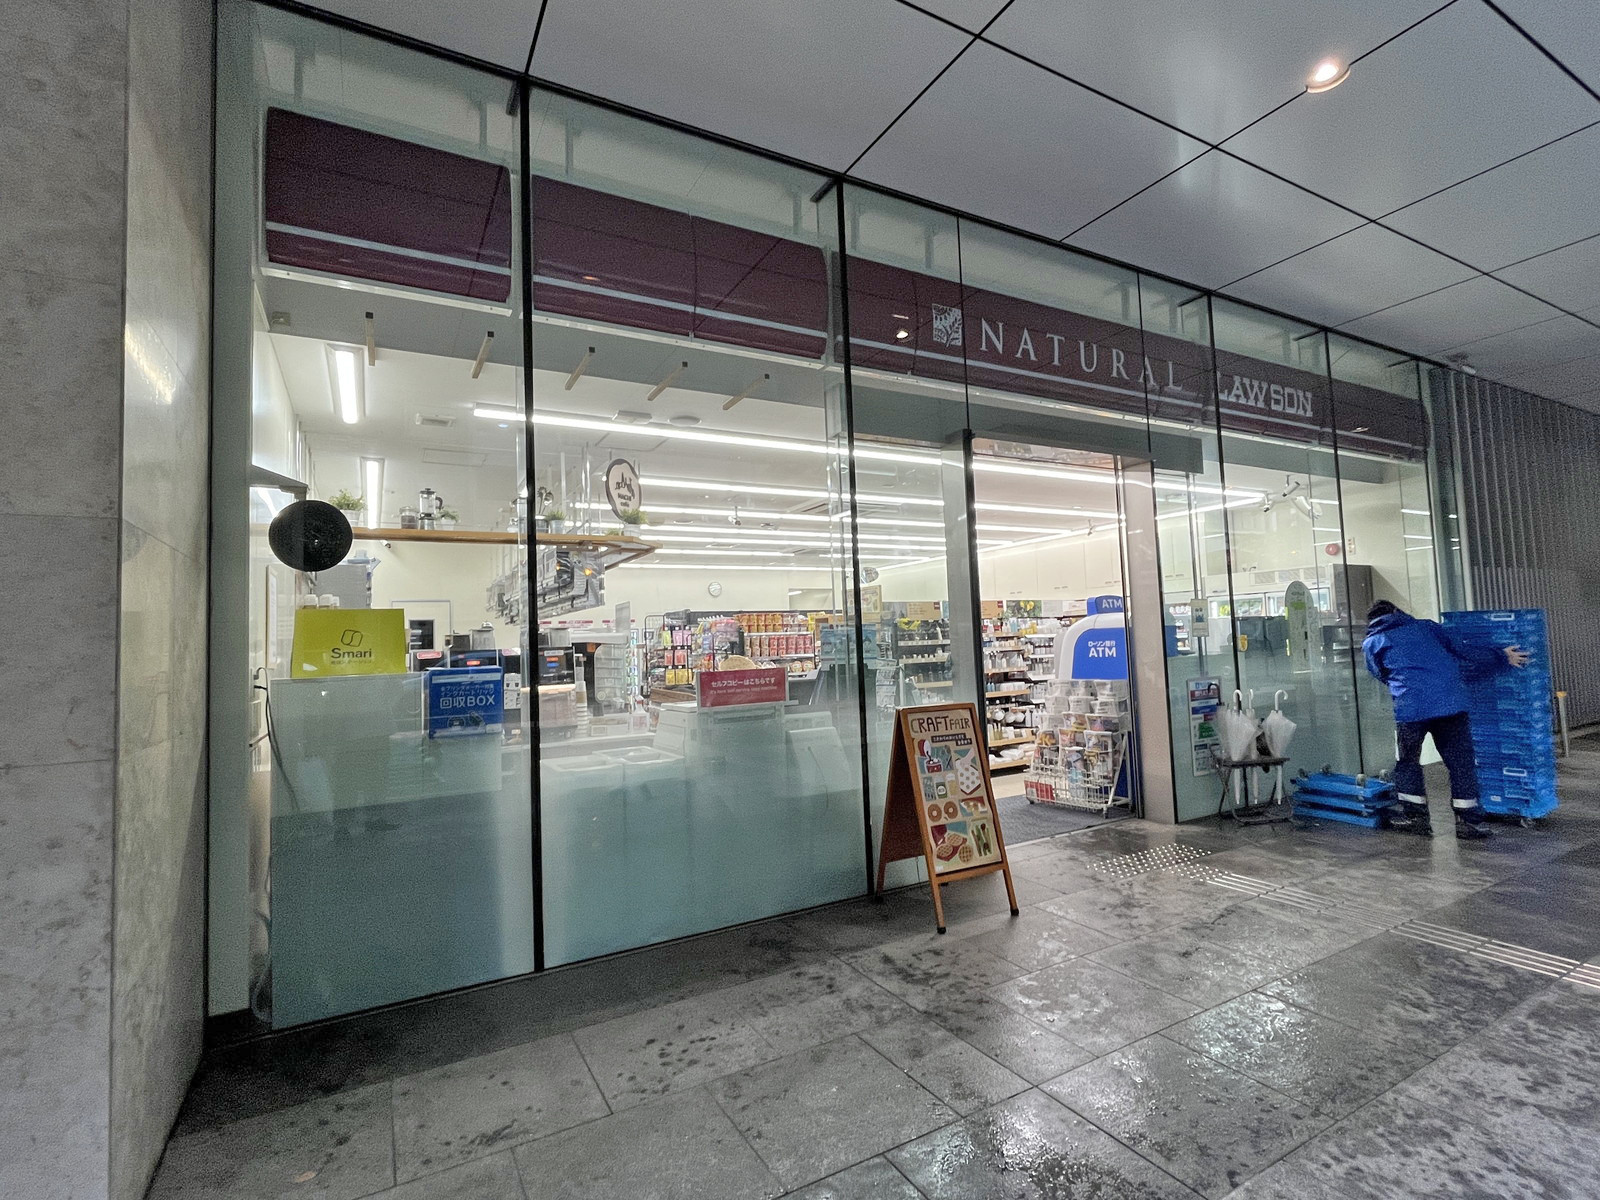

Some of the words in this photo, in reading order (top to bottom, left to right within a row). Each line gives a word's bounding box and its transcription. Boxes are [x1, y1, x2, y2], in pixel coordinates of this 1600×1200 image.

[979, 317, 1183, 392] NATURAL
[1212, 370, 1313, 417] LAWSON
[1102, 598, 1123, 609] ATM
[331, 647, 372, 659] Smari
[1089, 647, 1117, 658] ATM
[440, 695, 496, 710] 回収BOX
[911, 715, 949, 733] CRAFT
[950, 717, 971, 730] FAIR
